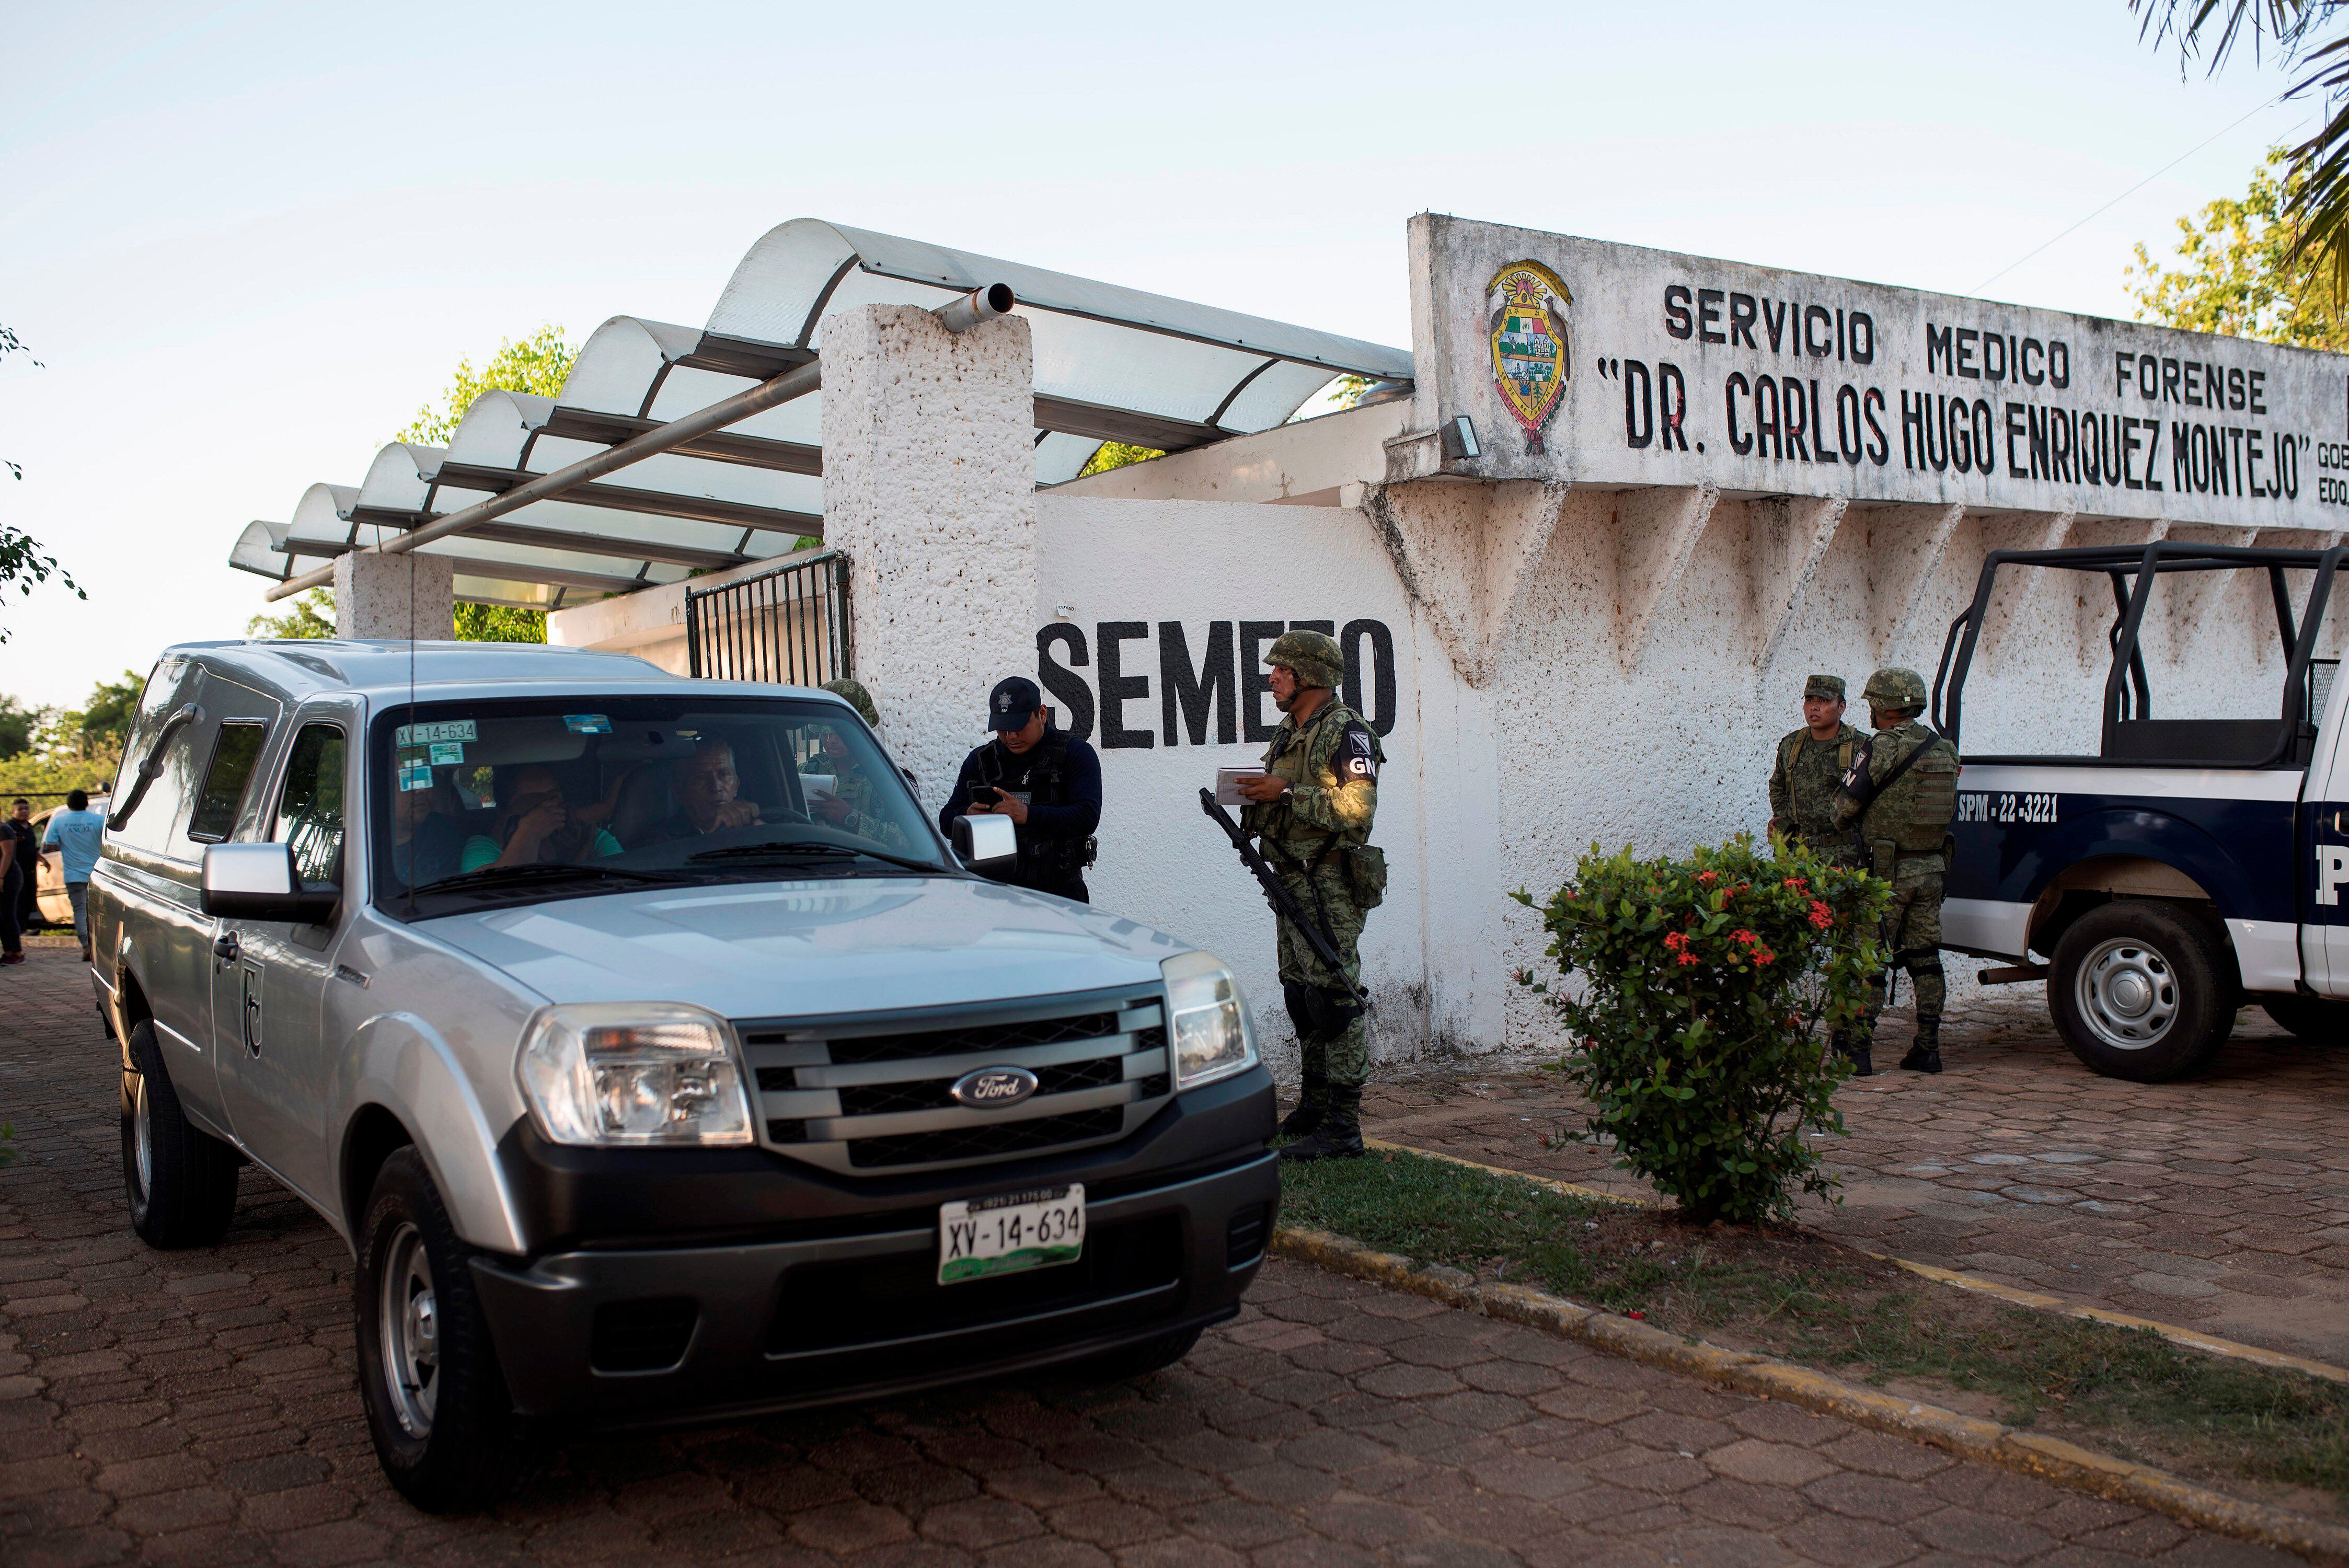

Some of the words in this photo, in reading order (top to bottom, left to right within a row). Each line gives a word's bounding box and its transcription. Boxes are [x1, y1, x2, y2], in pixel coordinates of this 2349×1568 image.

[1664, 285, 1874, 365] SERVICIO
[1927, 324, 2070, 389] MEDICO
[2116, 352, 2267, 414] FORENSE
[1508, 387, 1515, 397] DE
[1549, 374, 1558, 390] 1863
[1726, 372, 1889, 466] CARLOS
[1900, 389, 1995, 475] HUGO
[2006, 402, 2163, 490] ENRIQUEZ
[1036, 618, 1397, 749] SEMEO
[1349, 757, 1376, 778] GN
[1841, 767, 1857, 787] N
[974, 1075, 1019, 1099] Ford
[949, 1205, 1079, 1259] XV-14-634
